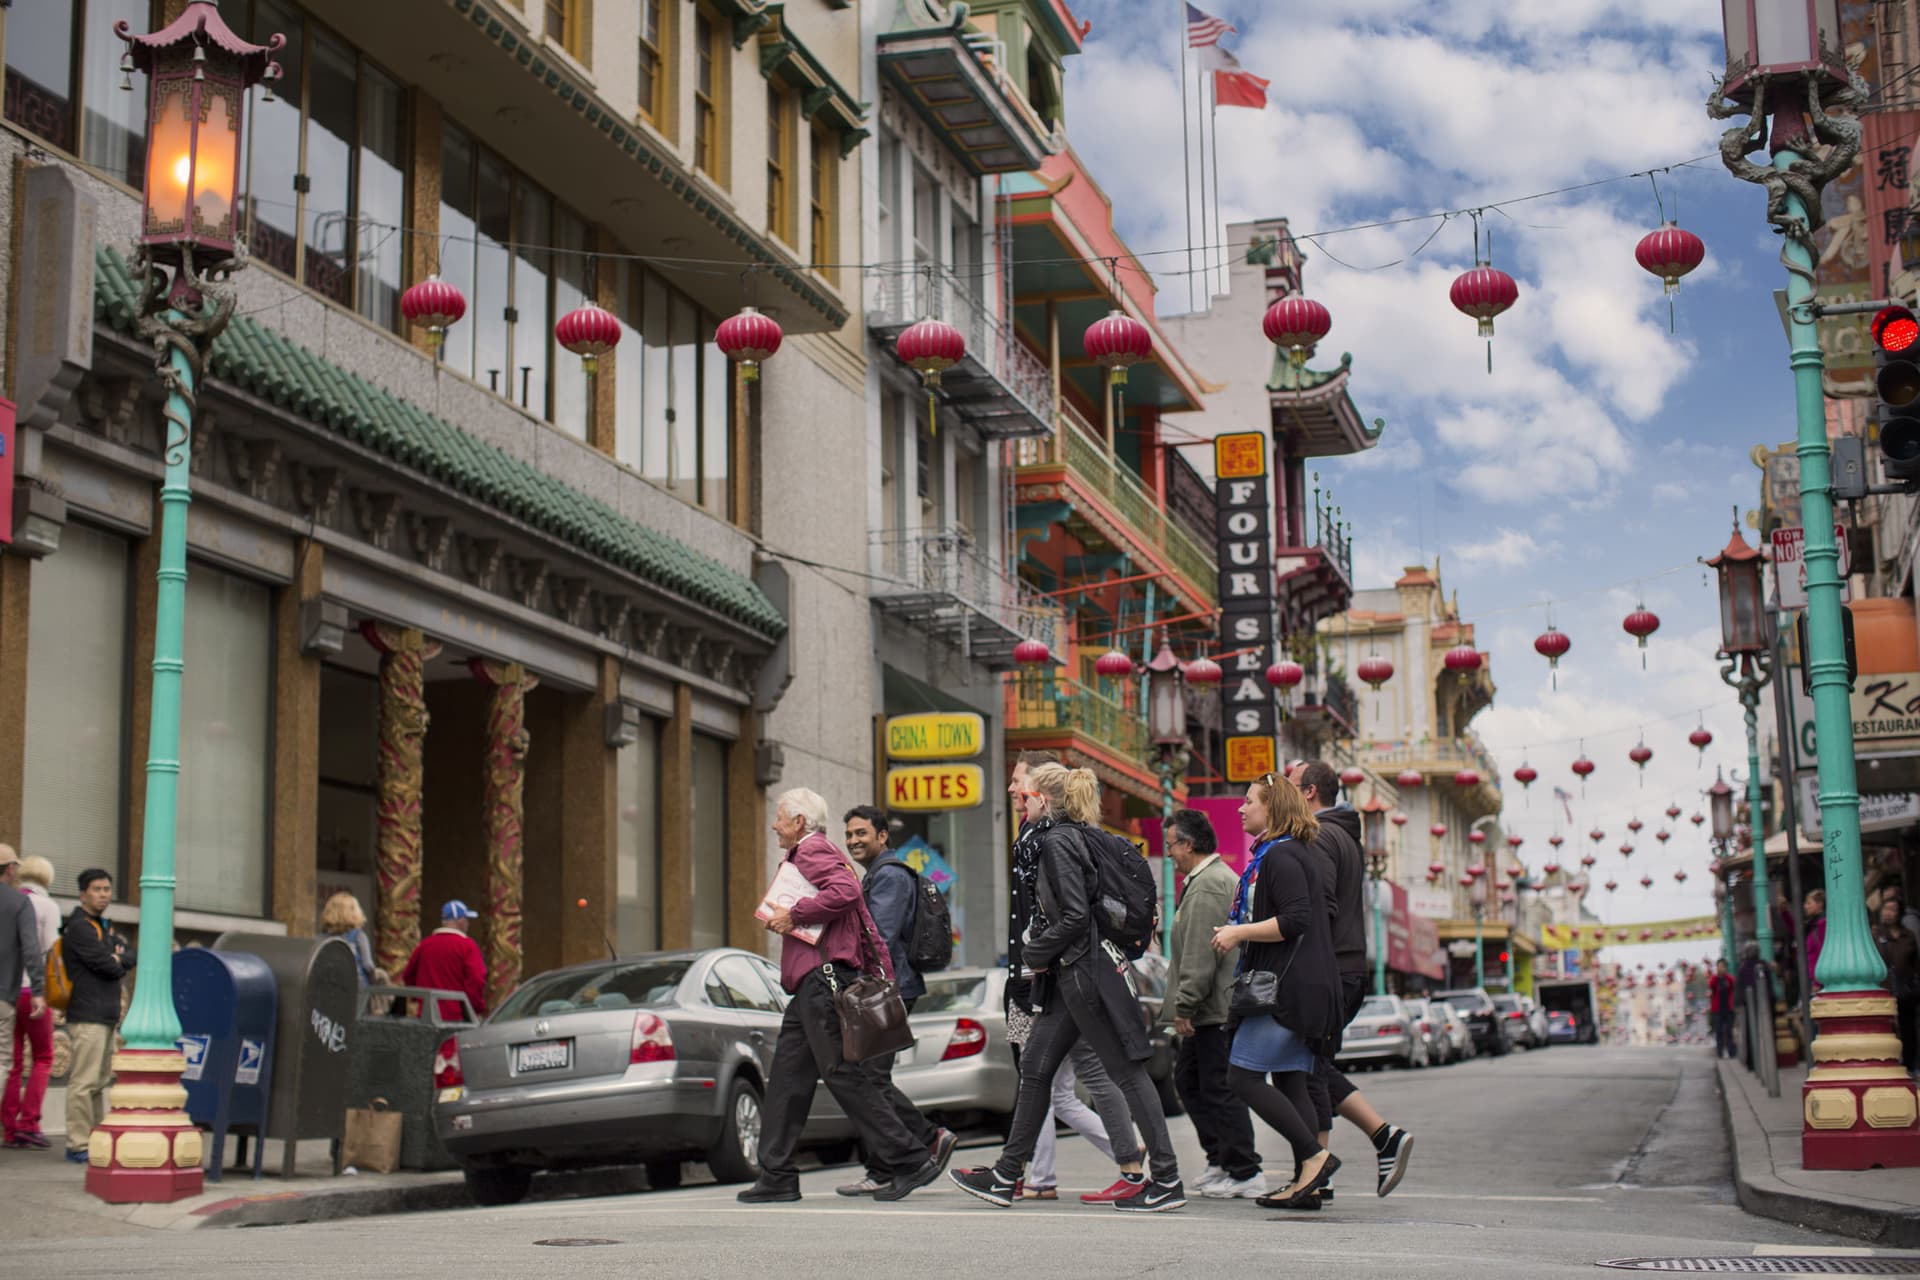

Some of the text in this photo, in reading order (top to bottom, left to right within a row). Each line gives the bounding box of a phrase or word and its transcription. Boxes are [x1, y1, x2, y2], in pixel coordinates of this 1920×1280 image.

[1228, 481, 1260, 595] FOUR
[1233, 618, 1265, 732] SEAS
[891, 722, 972, 751] CHINA TOWN
[1853, 719, 1920, 734] ESTAURAN
[895, 774, 968, 801] KITES
